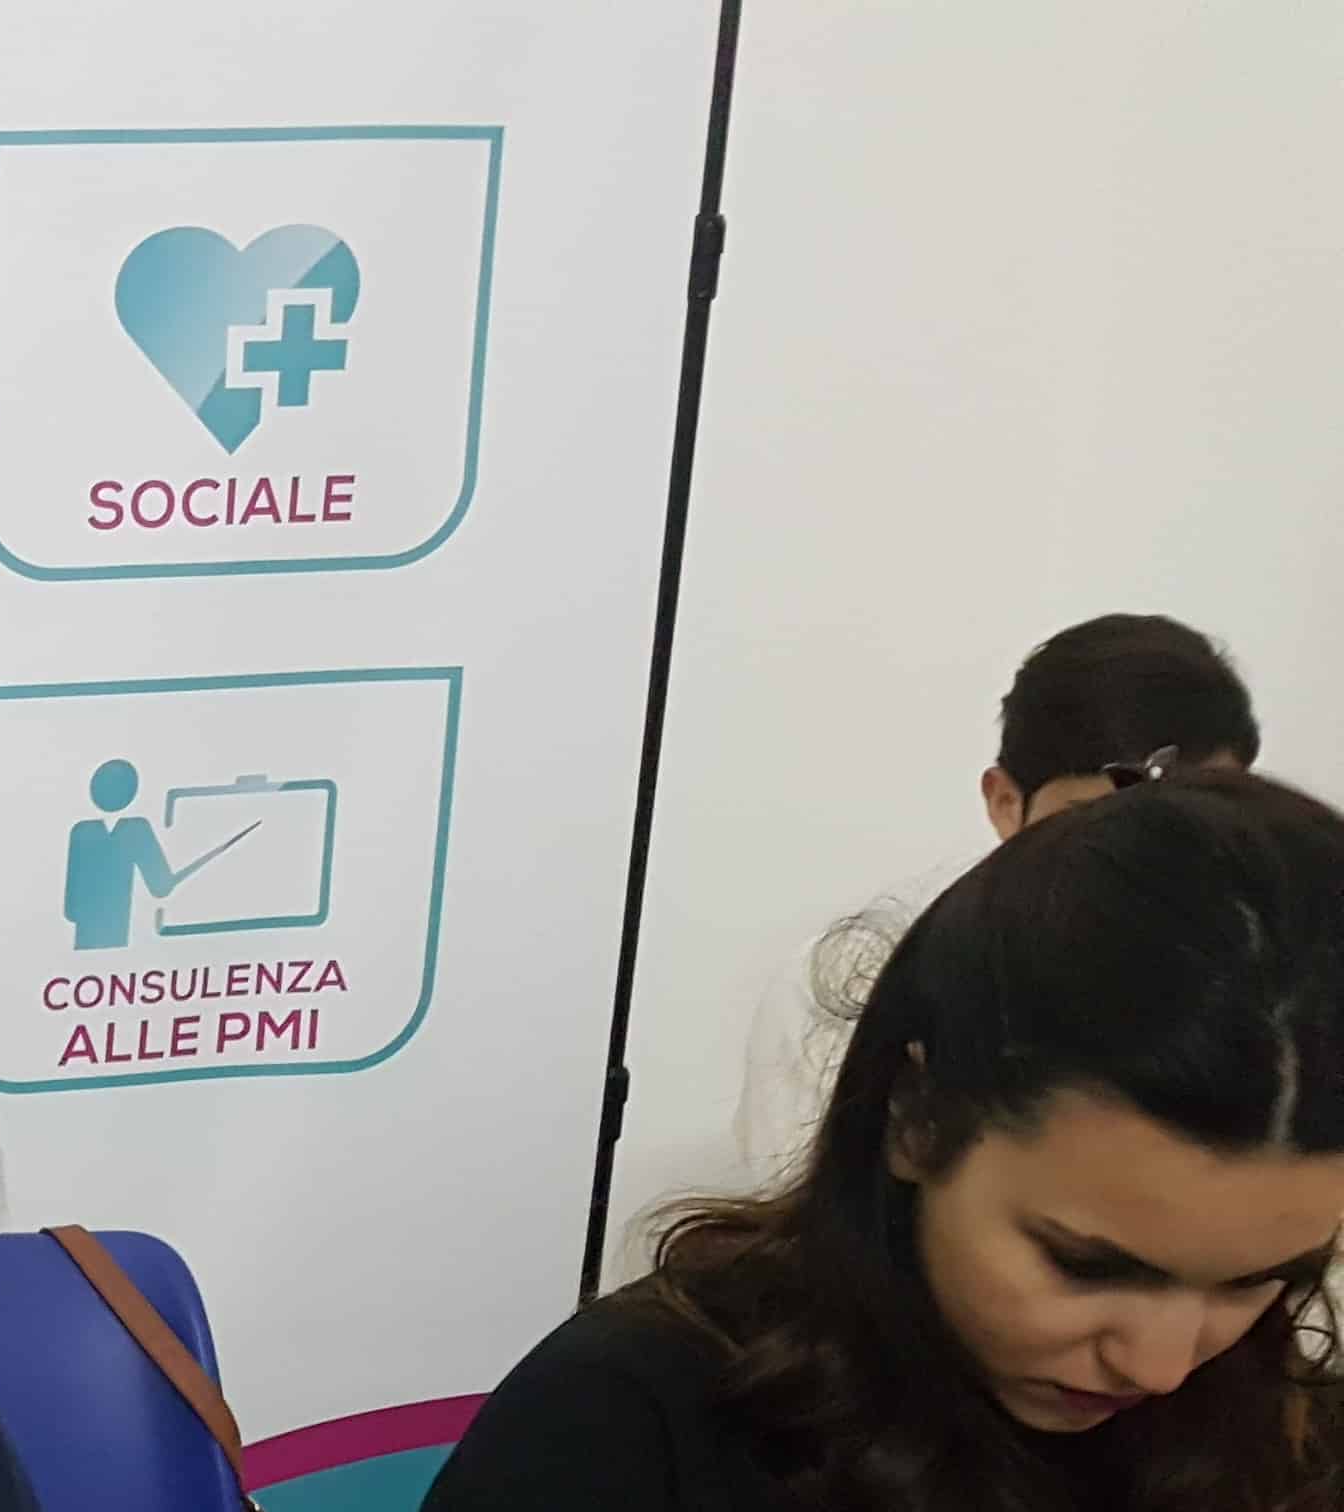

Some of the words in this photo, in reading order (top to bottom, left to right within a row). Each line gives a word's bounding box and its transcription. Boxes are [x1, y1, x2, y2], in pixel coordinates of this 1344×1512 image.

[87, 474, 356, 530] SOCIALE
[42, 960, 348, 1011] CONSULENZA
[58, 1016, 200, 1065] ALLE
[216, 1009, 320, 1053] PMI
